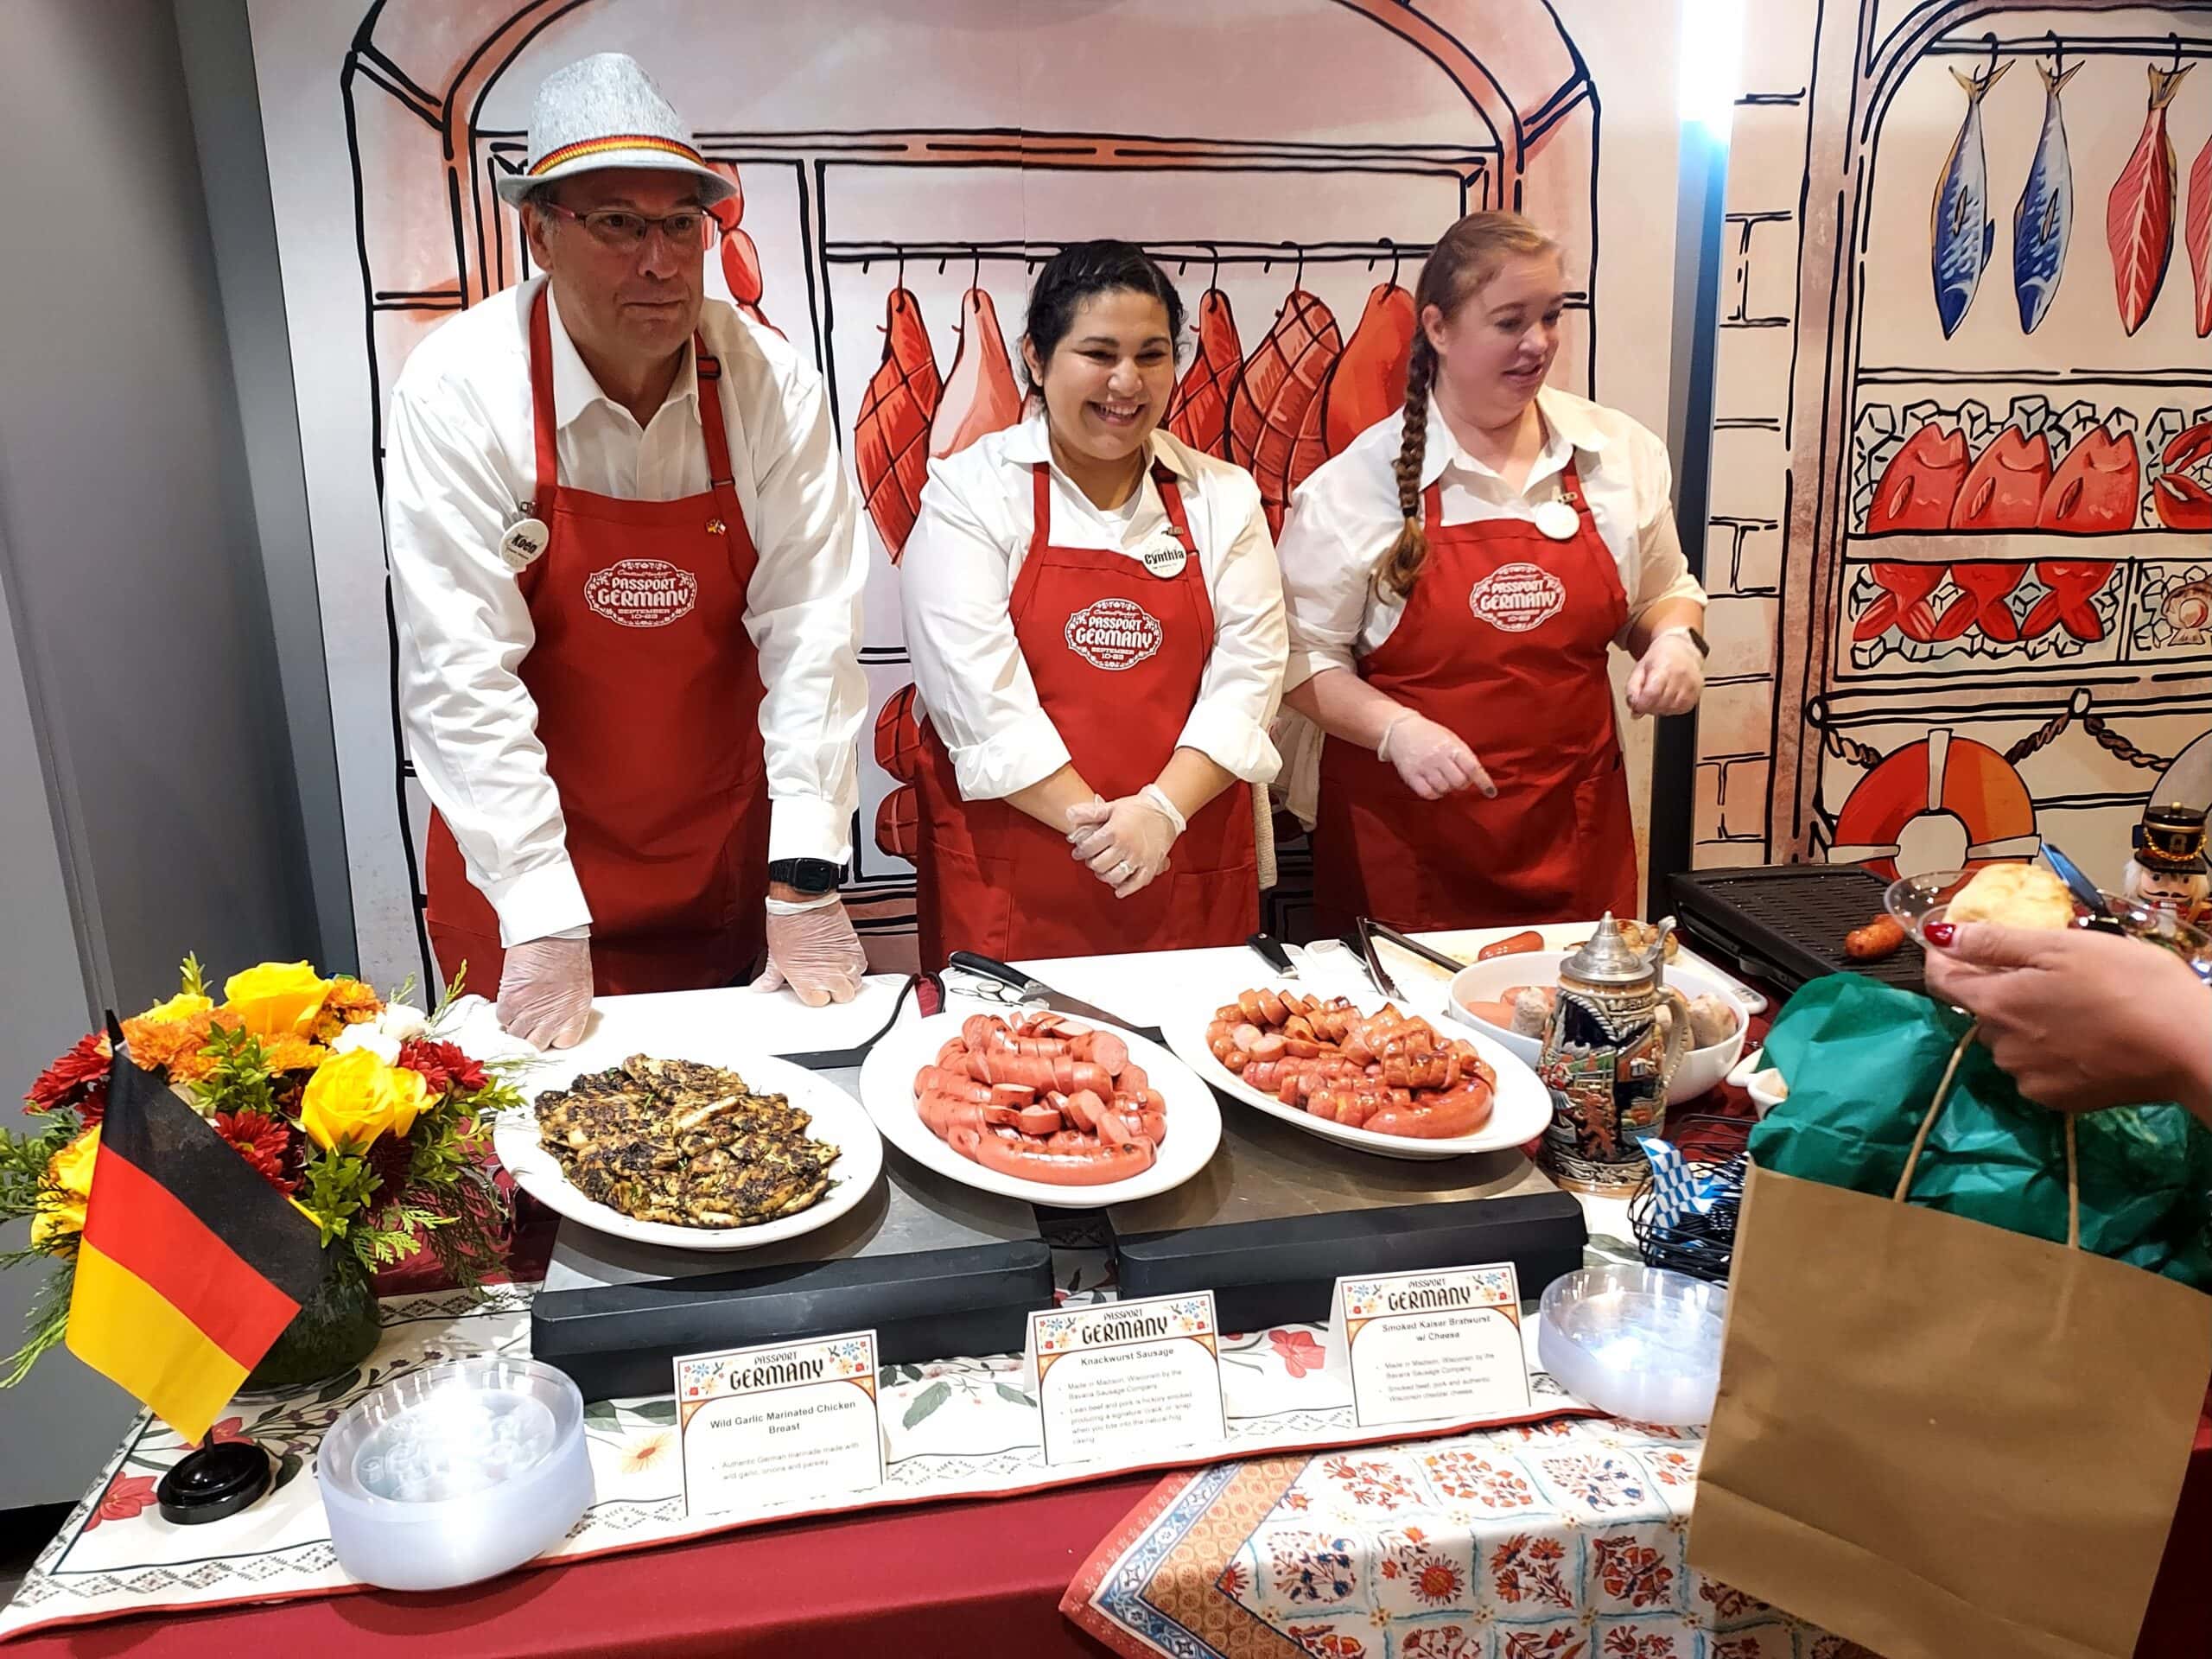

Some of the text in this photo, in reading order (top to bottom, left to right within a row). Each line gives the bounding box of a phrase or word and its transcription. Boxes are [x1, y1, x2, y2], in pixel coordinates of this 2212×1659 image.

[1144, 549, 1184, 564] Cynthia
[612, 577, 677, 590] PASSPORT
[1491, 580, 1544, 594] PASSPORT
[597, 588, 689, 607] GERMANY
[1480, 592, 1555, 611] GERMANY
[1089, 616, 1142, 631] PASSPORT
[1076, 627, 1153, 648] GERMANY
[1408, 1278, 1446, 1288] PASSPORT
[1388, 1286, 1471, 1311] GERMANY
[1103, 1308, 1142, 1320] PASSPORT
[1082, 1316, 1167, 1344] GERMANY
[1382, 1315, 1491, 1332] Smoked Kaiser Bratwurst
[1428, 1332, 1460, 1340] Cheese
[754, 1351, 798, 1365] PASSPORT
[1081, 1348, 1174, 1366] Knackwurst Sausage
[730, 1358, 823, 1389] GERMANY
[710, 1401, 856, 1429] Wild Garlic Marinated Chicken
[768, 1422, 800, 1434] Breast
